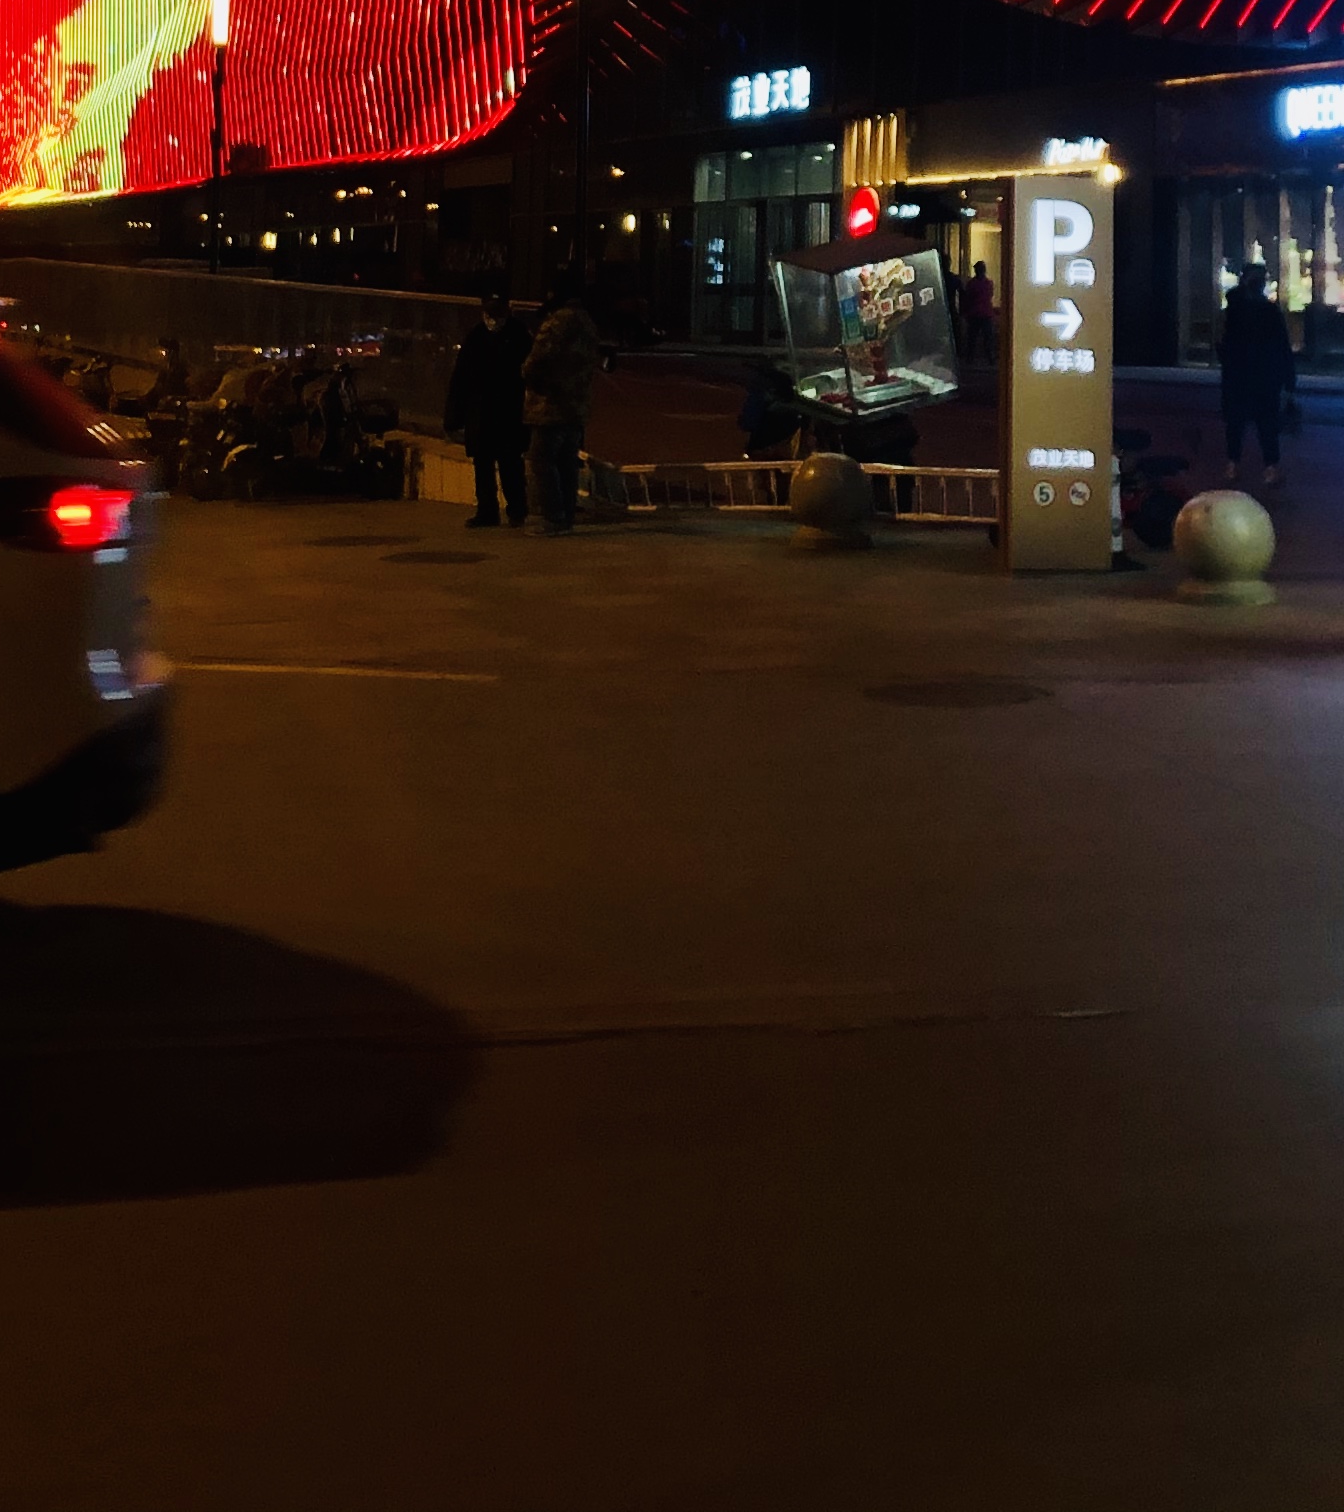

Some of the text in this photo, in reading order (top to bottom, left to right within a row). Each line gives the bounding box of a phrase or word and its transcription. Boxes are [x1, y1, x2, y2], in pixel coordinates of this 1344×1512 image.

[730, 65, 811, 119] 茂业天地
[1032, 198, 1094, 285] P
[1030, 347, 1095, 373] 停车场
[1027, 448, 1095, 469] 茂业天地
